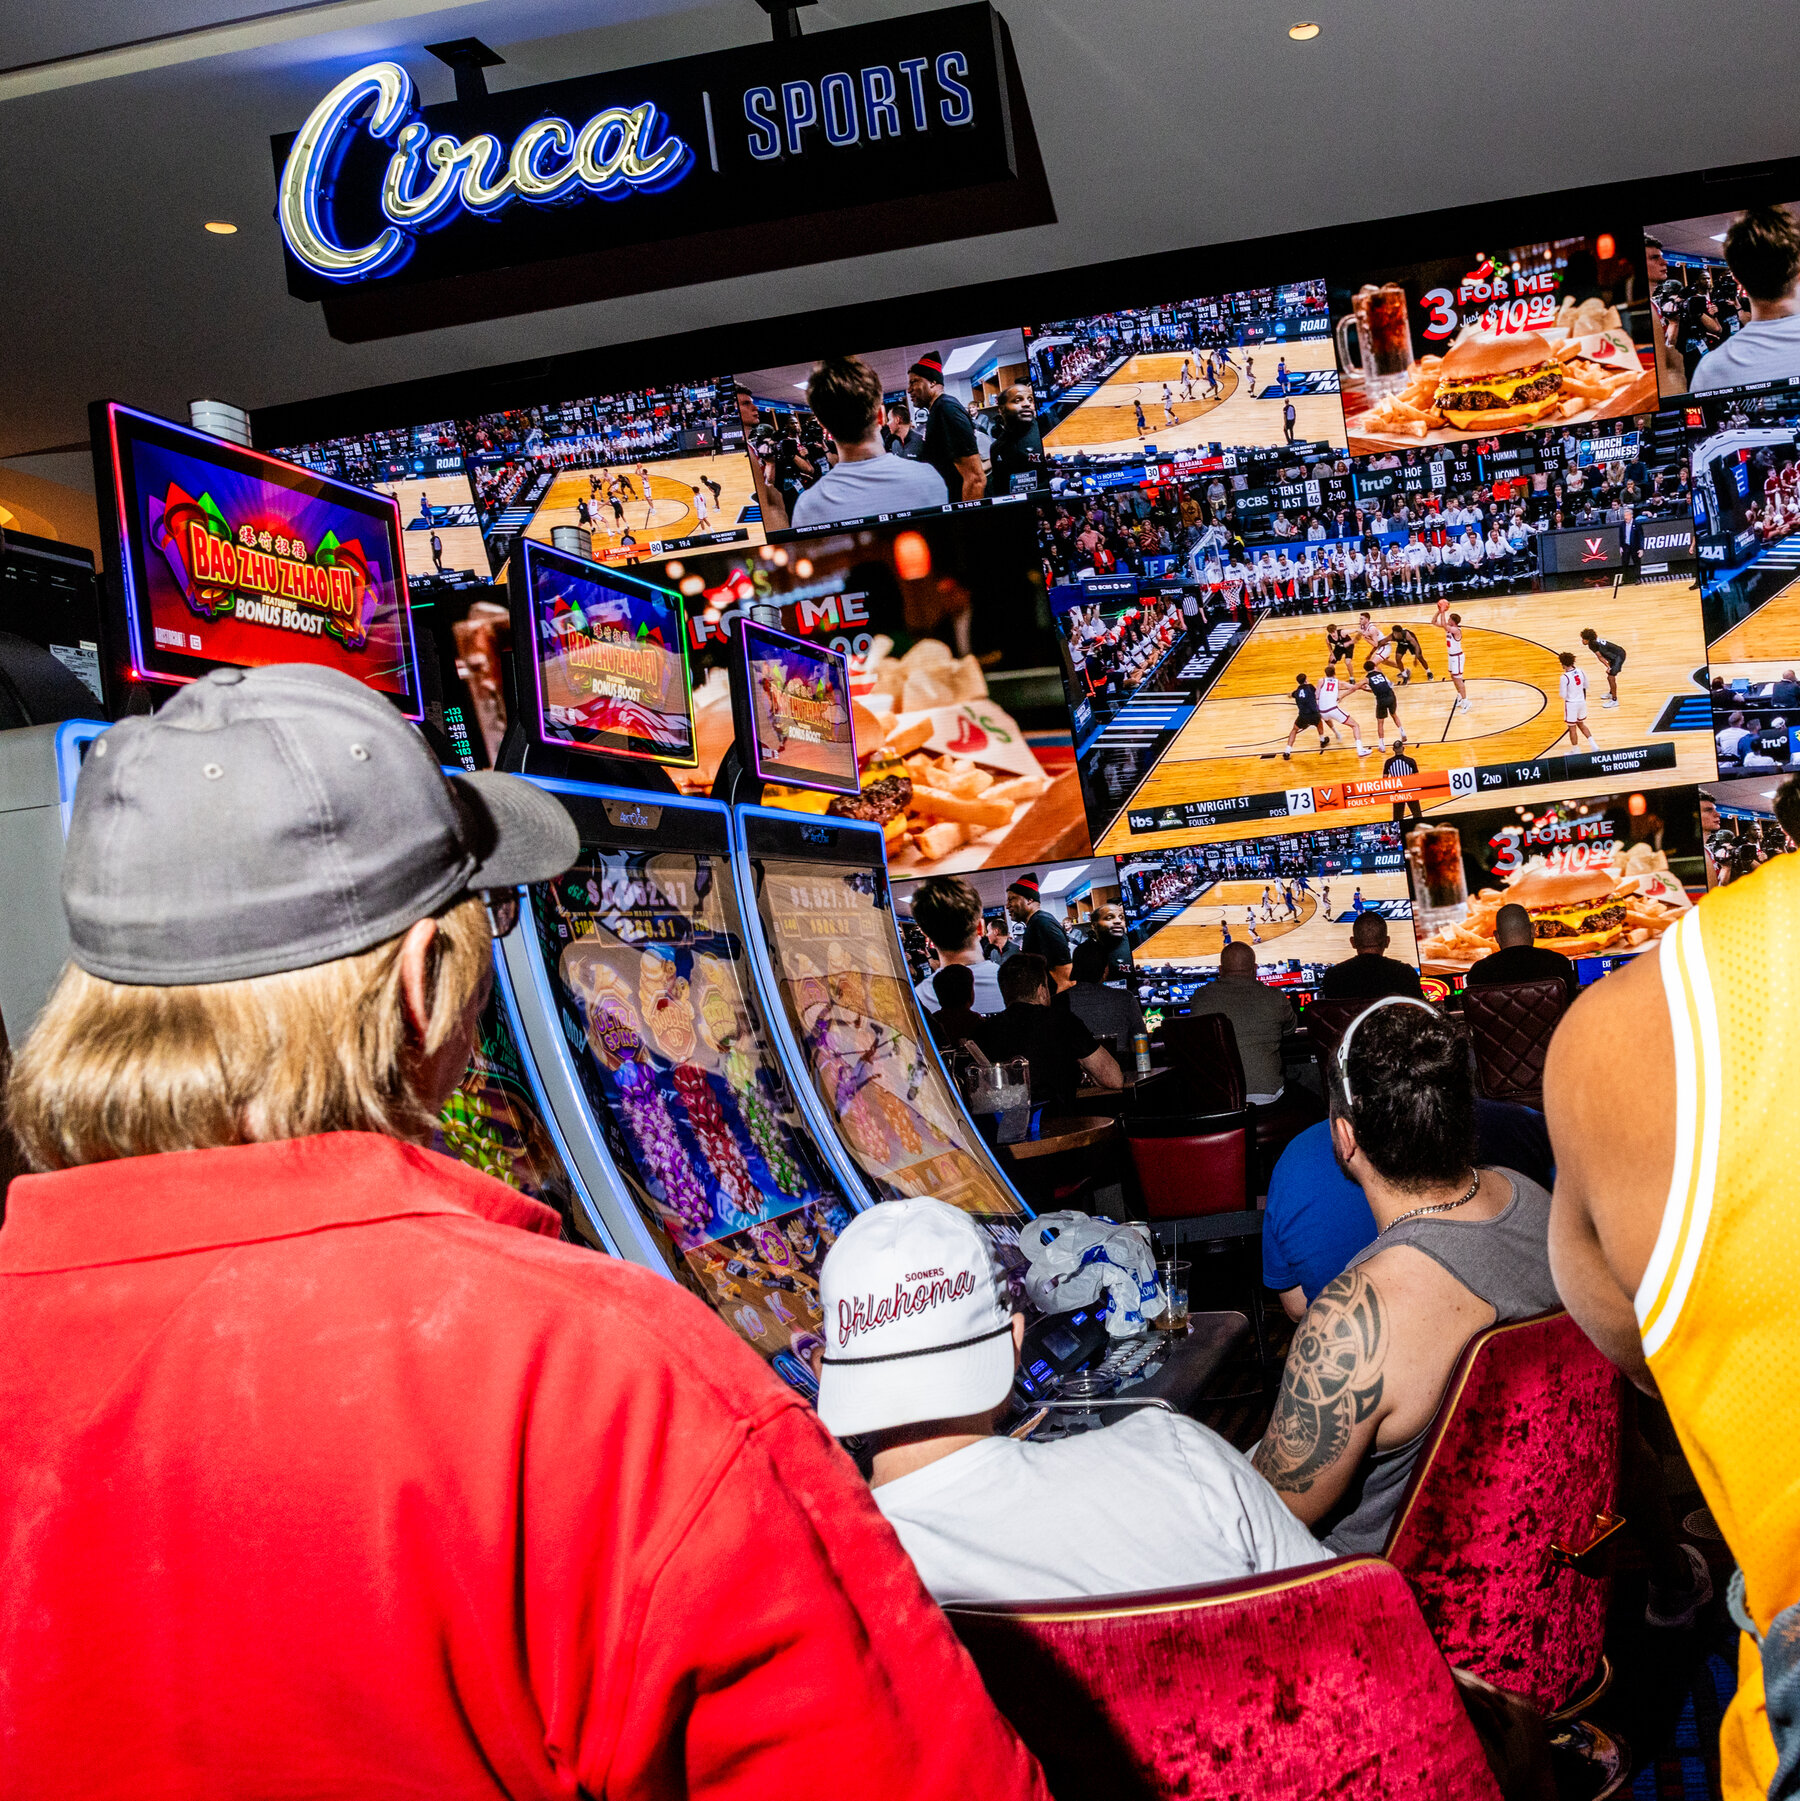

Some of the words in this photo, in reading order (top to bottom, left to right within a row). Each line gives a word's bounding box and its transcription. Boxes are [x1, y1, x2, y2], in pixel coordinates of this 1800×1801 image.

[280, 60, 692, 282] Circa
[744, 51, 975, 161] SPORTS
[1421, 287, 1459, 337] 3
[1459, 275, 1509, 302] FOR
[1516, 271, 1556, 296] ME
[1300, 318, 1328, 332] ROAD
[1459, 311, 1483, 328] Just
[1255, 327, 1264, 335] LG
[722, 430, 743, 440] IRGINIA
[1590, 436, 1622, 450] MARCH
[1253, 452, 1267, 461] 4:41
[1270, 451, 1278, 459] 20
[1539, 448, 1550, 458] 10
[1551, 446, 1561, 456] ET
[1594, 445, 1638, 460] MADNESS
[436, 456, 461, 469] ROAD
[1178, 459, 1204, 468] ALABAMA
[1224, 456, 1236, 467] 23
[1454, 461, 1467, 471] 1ST
[1543, 460, 1559, 470] TBS
[1102, 471, 1125, 479] HOFSTRA
[1147, 467, 1158, 479] 30
[1404, 466, 1423, 478] HOF
[1432, 463, 1443, 473] 30
[1453, 471, 1472, 482] 4:35
[1270, 488, 1278, 496] 15
[1279, 485, 1294, 496] TEN
[1294, 483, 1304, 495] ST
[1307, 481, 1318, 493] 21
[1329, 479, 1343, 489] 1ST
[1406, 480, 1422, 490] ALA
[1433, 476, 1445, 487] 23
[1246, 495, 1269, 508] CBS
[1281, 499, 1292, 509] IA
[1292, 497, 1302, 508] ST
[1308, 494, 1320, 505] 46
[1328, 491, 1347, 501] 2:40
[651, 543, 661, 553] 80
[1643, 532, 1691, 550] IRGINIA
[191, 521, 237, 585] BAO
[236, 545, 279, 594] ZHU
[280, 558, 331, 607] ZHAO
[330, 566, 354, 615] FU
[261, 594, 298, 610] FEATURING
[235, 598, 282, 626] BONUS
[281, 608, 324, 634] BOOST
[800, 591, 870, 628] ME
[1370, 674, 1385, 685] 55
[1573, 674, 1581, 687] 5
[592, 678, 618, 697] BONUS
[617, 683, 641, 702] BOOST
[1298, 688, 1306, 698] 4
[444, 707, 462, 715] -133
[445, 715, 463, 723] +113
[450, 731, 468, 739] -570
[452, 740, 470, 748] -123
[1591, 754, 1611, 765] NCAA
[1612, 749, 1648, 763] MIDWEST
[1601, 763, 1612, 772] 1ST
[1613, 760, 1640, 771] ROUND
[1346, 785, 1352, 793] 3
[1355, 778, 1404, 793] VIRGINIA
[1451, 771, 1474, 790] 80
[1482, 772, 1502, 785] 2ND
[1515, 766, 1541, 782] 19.4
[1184, 804, 1195, 813] 14
[1196, 798, 1238, 813] WRIGHT
[1238, 796, 1250, 808] ST
[1289, 793, 1312, 811] 73
[1370, 797, 1376, 805] 4
[1389, 792, 1413, 802] BONUS
[1269, 806, 1288, 817] POSS
[1129, 812, 1154, 829] tbs
[1489, 831, 1525, 874] 3
[1525, 821, 1572, 845] FOR
[1579, 818, 1616, 839] ME
[1374, 854, 1401, 866] ROAD
[1260, 973, 1284, 982] ALABAMA
[1302, 971, 1314, 983] 23
[1298, 992, 1312, 1006] 73
[593, 1006, 638, 1035] ULTRA
[650, 1005, 691, 1036] DOUBLE
[605, 1031, 639, 1052] SPINS
[668, 1027, 685, 1047] UP
[904, 1267, 945, 1283] SOONERS
[837, 1269, 977, 1349] Oklahoma
